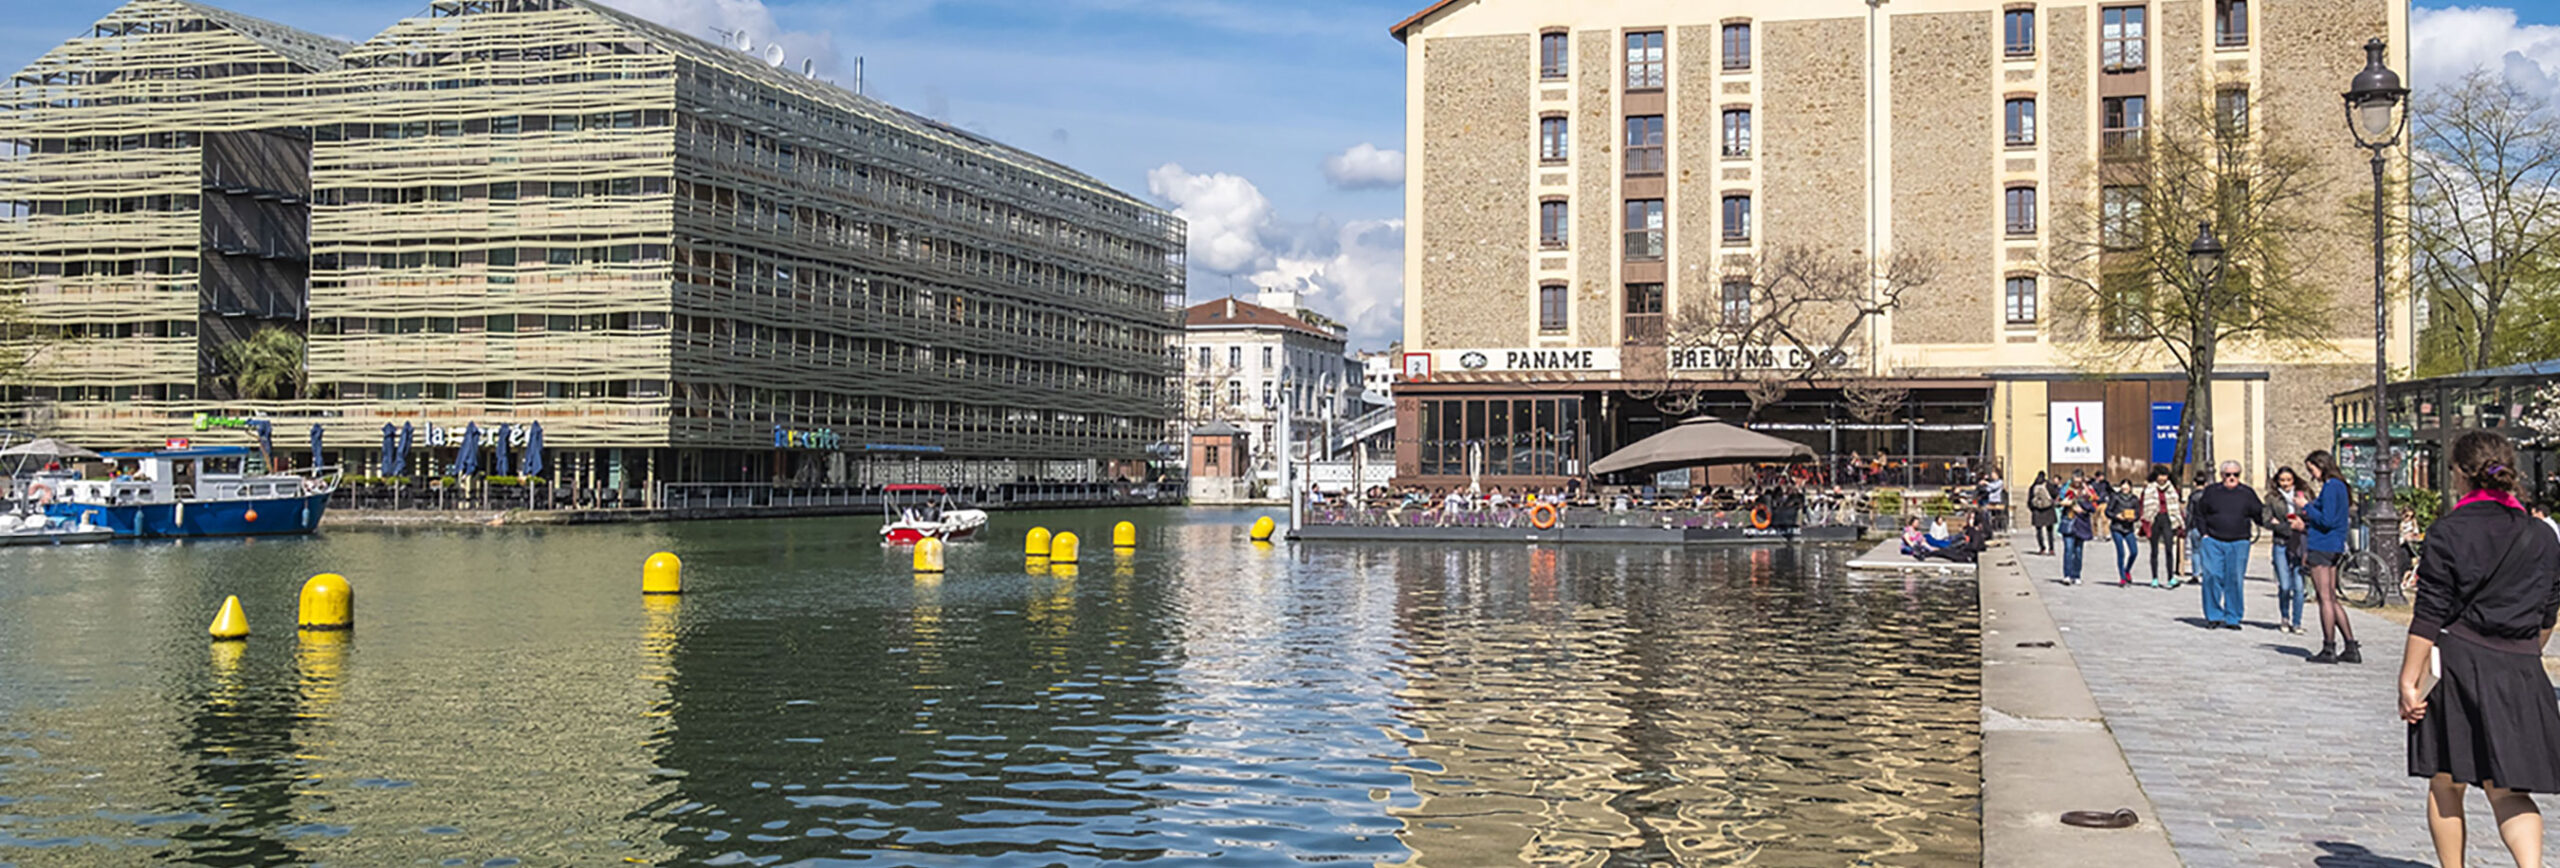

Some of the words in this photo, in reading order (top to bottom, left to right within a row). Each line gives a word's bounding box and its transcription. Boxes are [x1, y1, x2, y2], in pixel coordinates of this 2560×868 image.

[1506, 351, 1593, 369] PANAME
[1672, 349, 1774, 368] BREWNG
[425, 421, 445, 445] la
